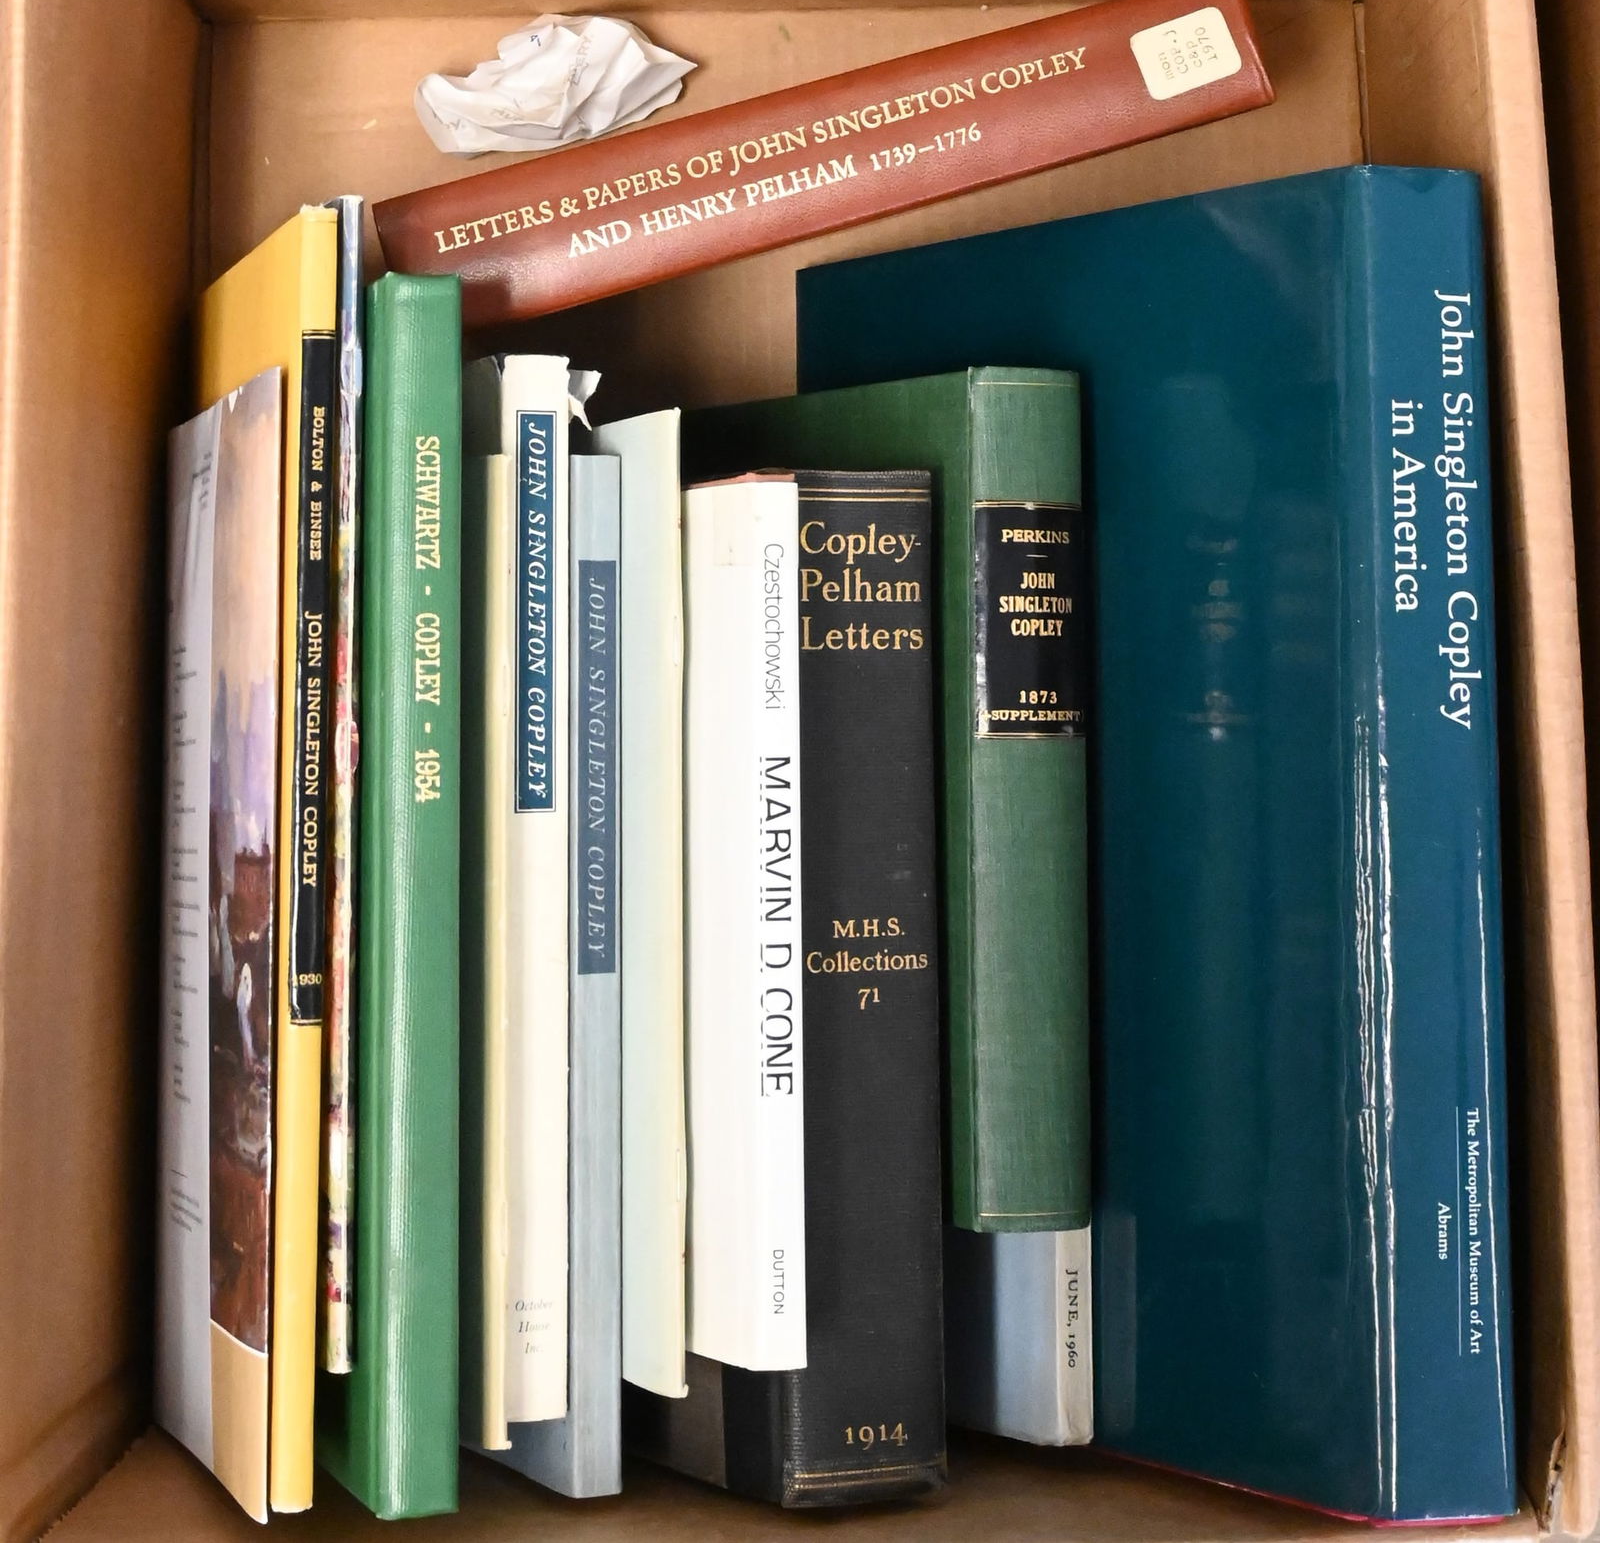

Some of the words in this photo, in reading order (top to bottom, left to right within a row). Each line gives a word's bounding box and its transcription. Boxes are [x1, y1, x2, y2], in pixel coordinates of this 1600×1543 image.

[1194, 26, 1218, 60] 1970
[434, 201, 554, 253] LETTERS
[559, 197, 580, 218] &
[582, 163, 682, 210] PAPERS
[686, 150, 724, 179] OF
[728, 125, 808, 176] JOHN
[812, 79, 977, 144] SINGLETON
[980, 47, 1087, 96] COPLEY
[568, 220, 632, 258] AND
[640, 189, 736, 237] HENRY
[745, 154, 858, 207] PELHAM
[1434, 289, 1475, 379] John
[311, 406, 325, 471] BOLTON
[1391, 399, 1424, 437] in
[311, 480, 323, 492] &
[528, 421, 546, 500] JOHN
[1434, 392, 1478, 577] Singleton
[415, 434, 441, 571] SCHWARTZ
[1392, 448, 1427, 613] America
[800, 521, 921, 564] Copley-
[1001, 529, 1070, 545] PERKINS
[527, 510, 547, 676] SINGLETON
[800, 568, 921, 603] Pelham
[999, 596, 1073, 614] SINGLETON
[1020, 572, 1055, 589] JOHN
[303, 610, 322, 668] JOHN
[589, 577, 606, 654] JOHN
[763, 542, 786, 711] Czestochowski
[801, 617, 924, 651] Letters
[1010, 618, 1064, 637] COPLEY
[415, 610, 441, 707] COPLEY
[1439, 591, 1483, 730] Copley
[1019, 690, 1057, 704] 1873
[303, 677, 321, 796] SINGLETON
[527, 687, 547, 800] COPLEY
[588, 666, 606, 833] SINGLETON
[415, 748, 441, 804] 1954
[302, 806, 319, 888] COPLEY
[760, 757, 792, 922] MARVIN
[588, 846, 606, 958] COPLEY
[833, 918, 906, 938] M.H.S.
[806, 950, 928, 973] Collections
[858, 987, 881, 1011] 71
[760, 987, 793, 1098] CONE
[1467, 1108, 1480, 1136] The
[1465, 1141, 1481, 1236] Metropolitan
[1438, 1202, 1452, 1260] Abrams
[773, 1249, 785, 1315] DUTTON
[1065, 1269, 1080, 1327] JUNE,
[1469, 1241, 1482, 1306] Museum
[1470, 1309, 1484, 1325] of
[1470, 1329, 1481, 1354] Art
[1065, 1333, 1077, 1369] 1960
[845, 1423, 909, 1451] 1914
